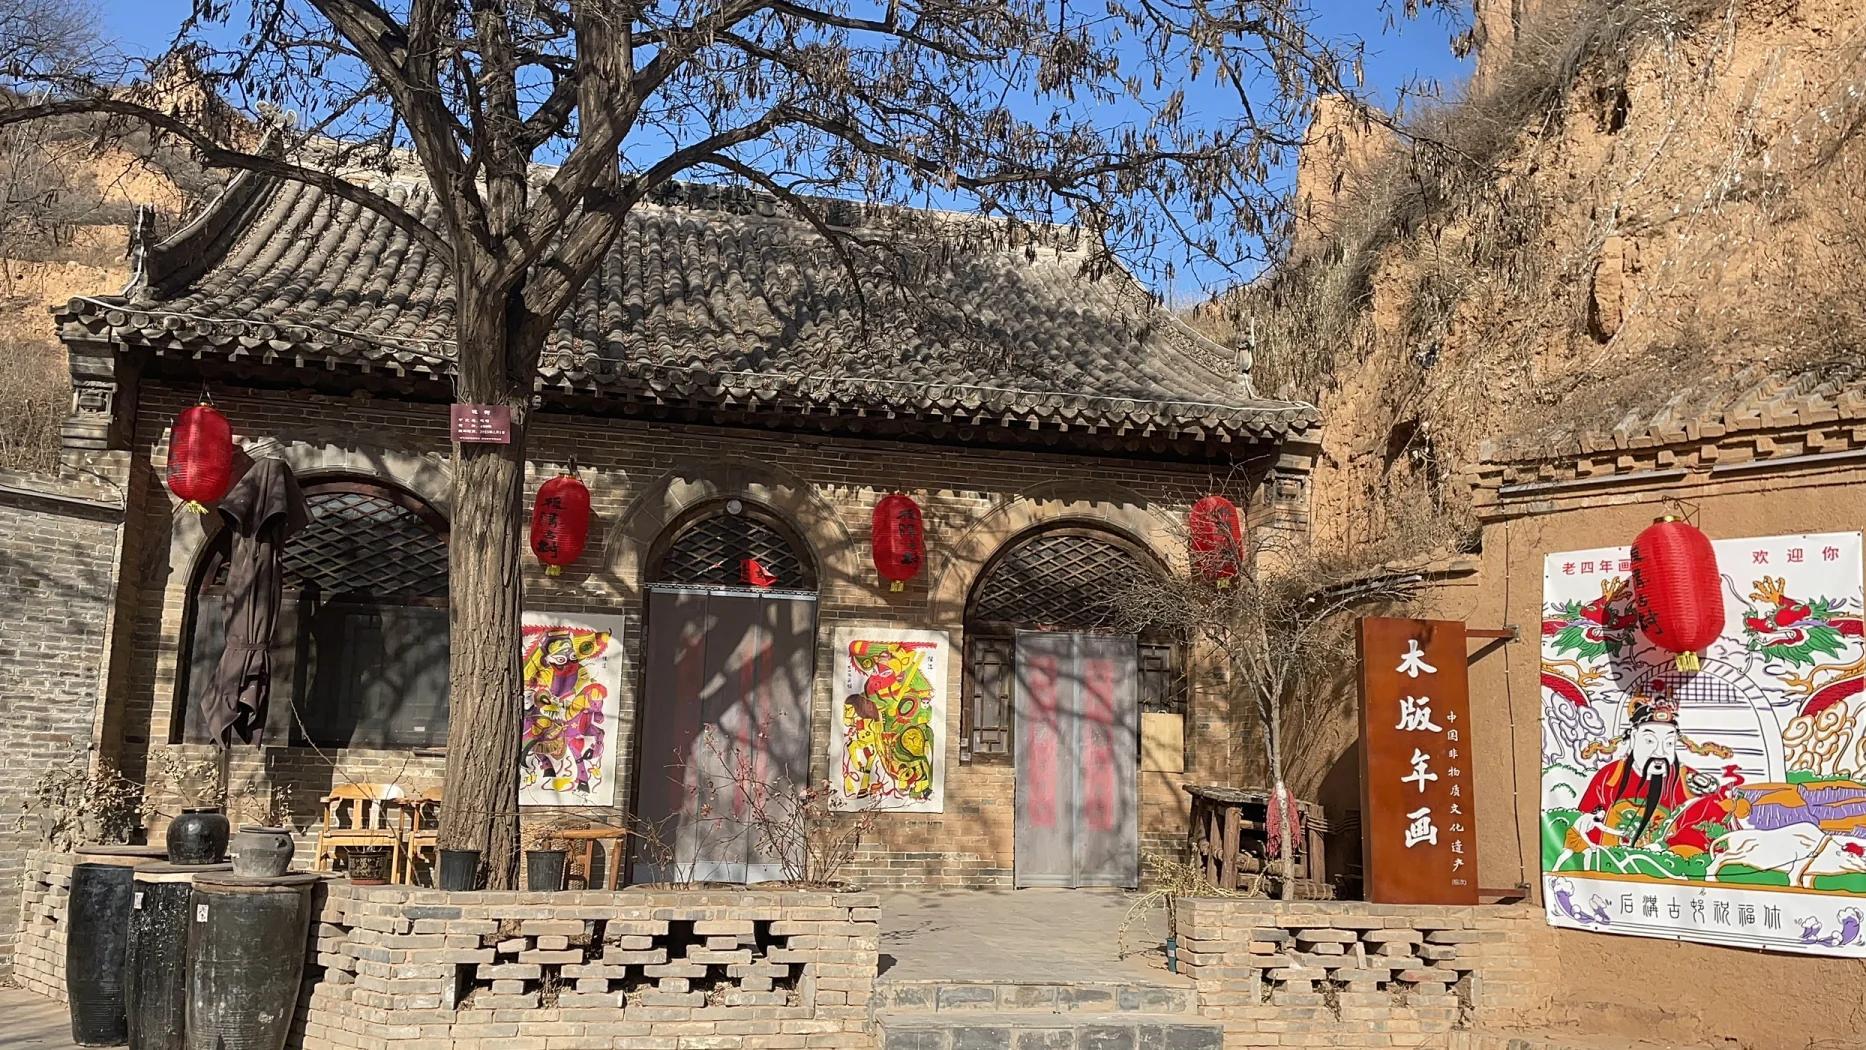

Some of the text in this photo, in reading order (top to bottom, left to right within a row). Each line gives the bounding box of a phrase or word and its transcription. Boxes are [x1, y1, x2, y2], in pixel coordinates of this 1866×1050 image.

[1562, 559, 1632, 576] 老四年画
[1752, 546, 1840, 564] 欢迎你
[1395, 639, 1443, 848] 木版年画
[1447, 710, 1465, 873] 中国非物质文化遗产
